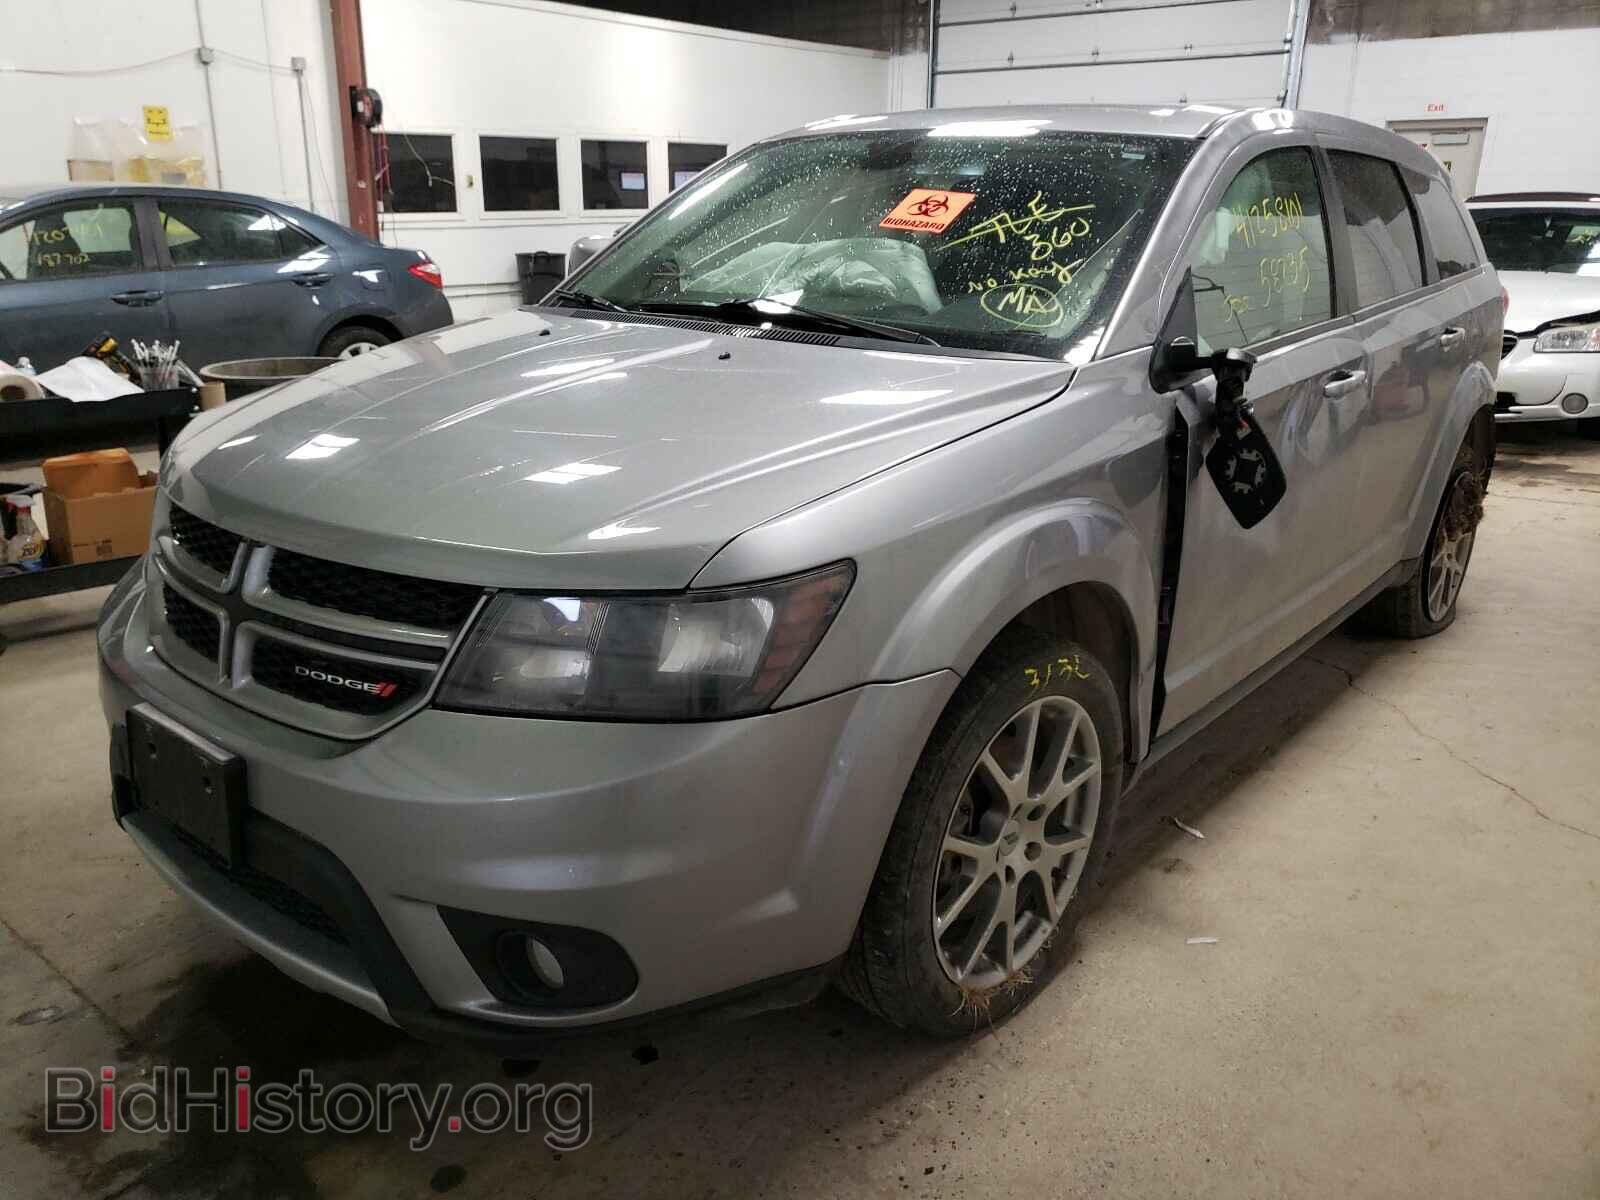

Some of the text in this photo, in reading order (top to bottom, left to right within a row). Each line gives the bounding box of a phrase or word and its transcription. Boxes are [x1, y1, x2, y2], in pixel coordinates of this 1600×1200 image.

[1427, 103, 1444, 112] Exit
[884, 217, 945, 230] BIOHAZARD
[1024, 217, 1089, 260] 360
[295, 666, 381, 695] DODGE
